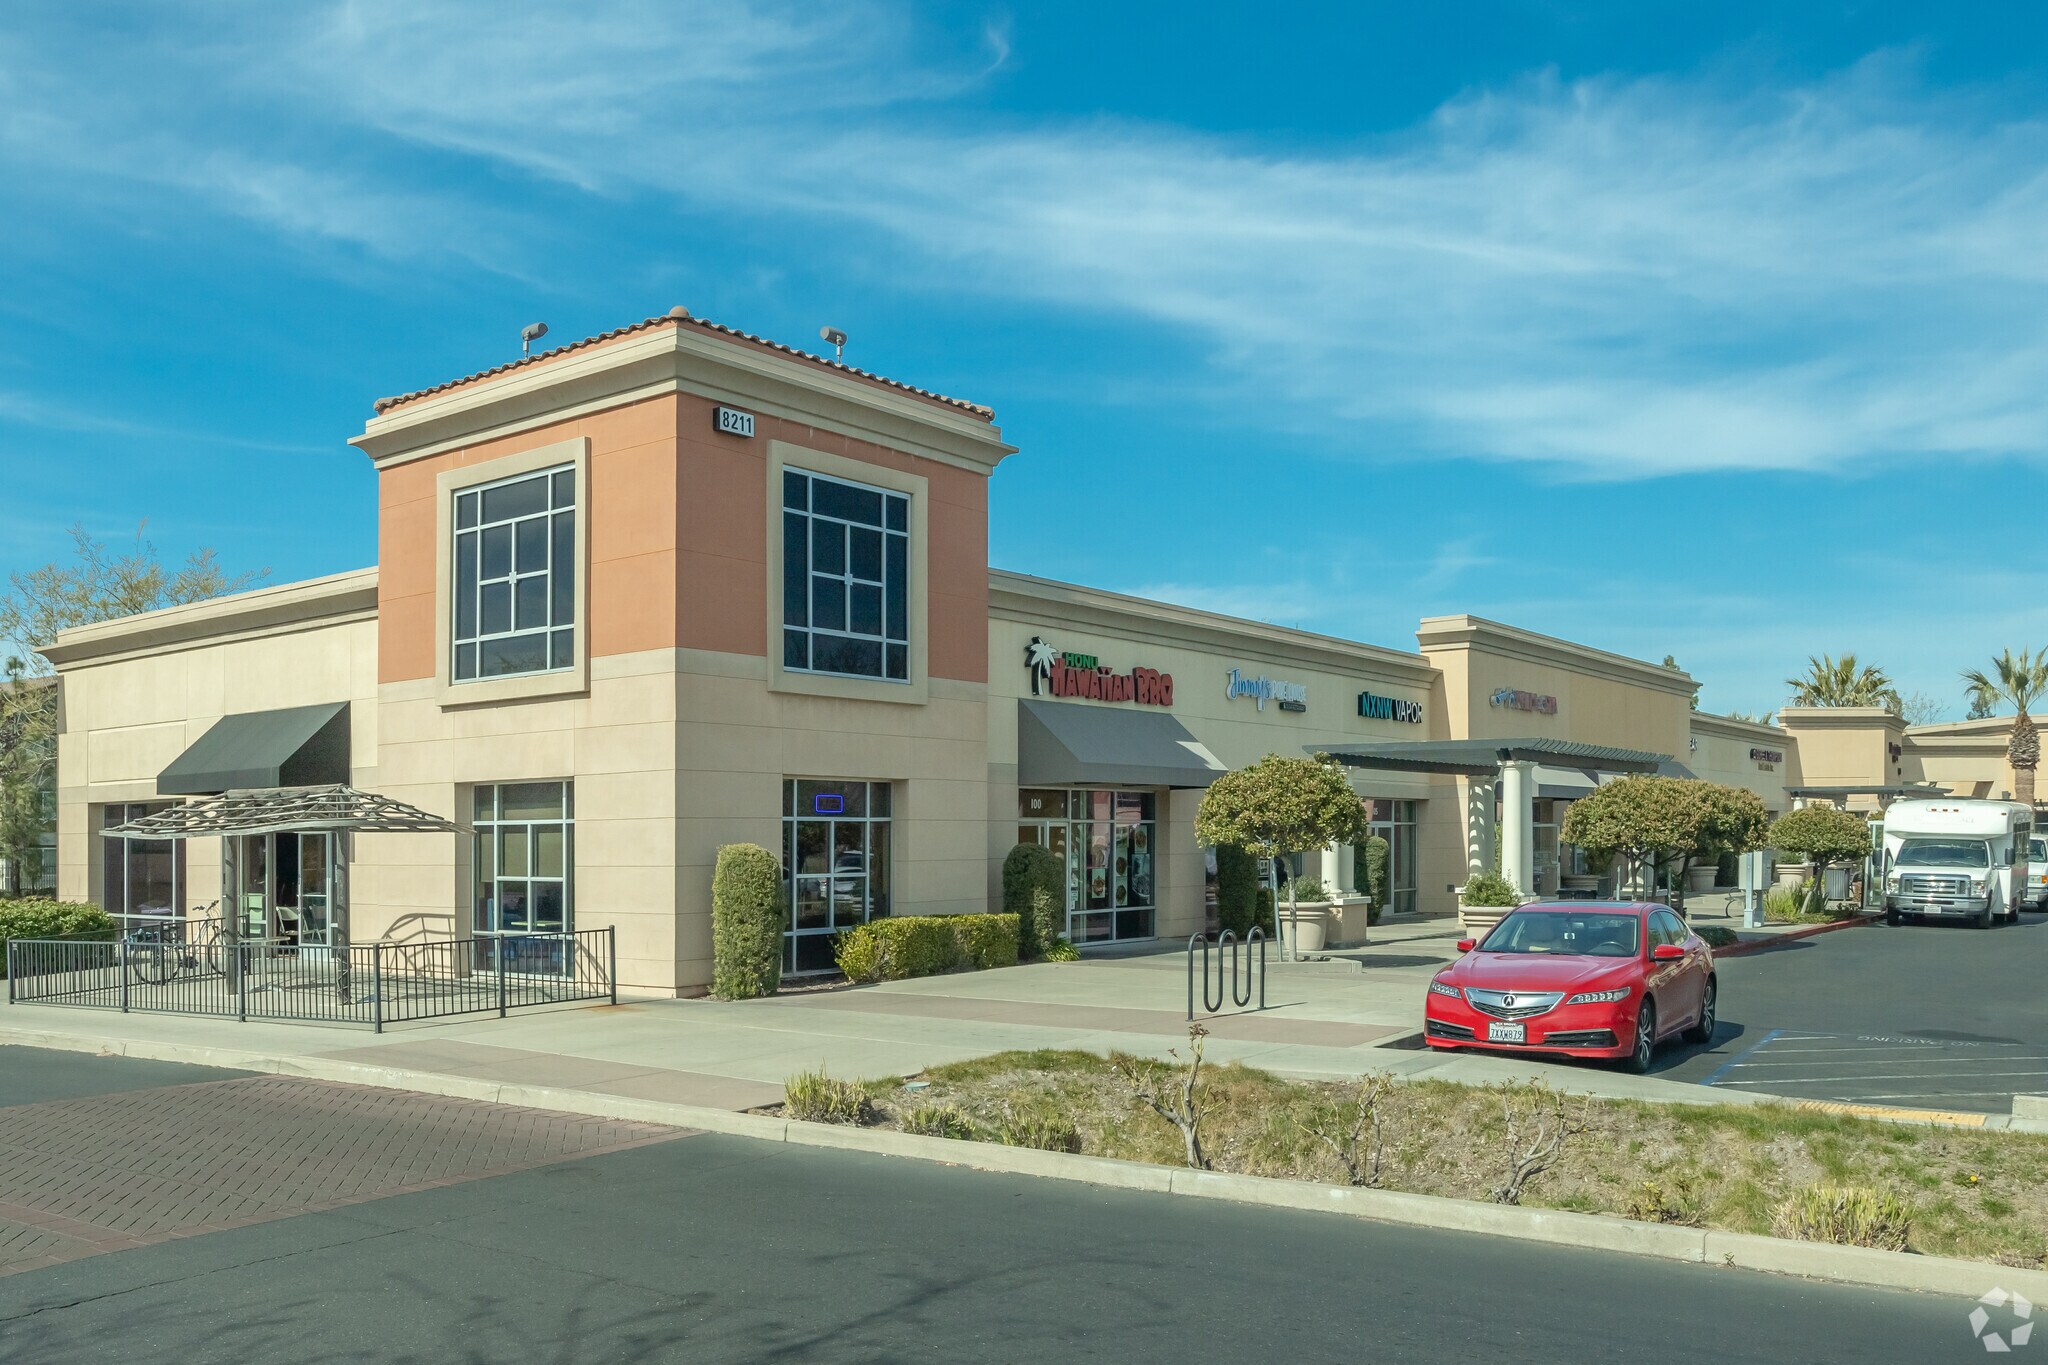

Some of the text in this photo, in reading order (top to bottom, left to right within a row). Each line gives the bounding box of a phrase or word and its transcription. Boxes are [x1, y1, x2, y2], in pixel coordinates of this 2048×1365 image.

[722, 411, 752, 434] 8211
[1062, 652, 1099, 669] HONU
[1133, 666, 1174, 706] BBQ
[1227, 667, 1271, 711] Jimmy's
[1361, 692, 1423, 723] NXNW VAPOR
[1030, 798, 1042, 809] 100
